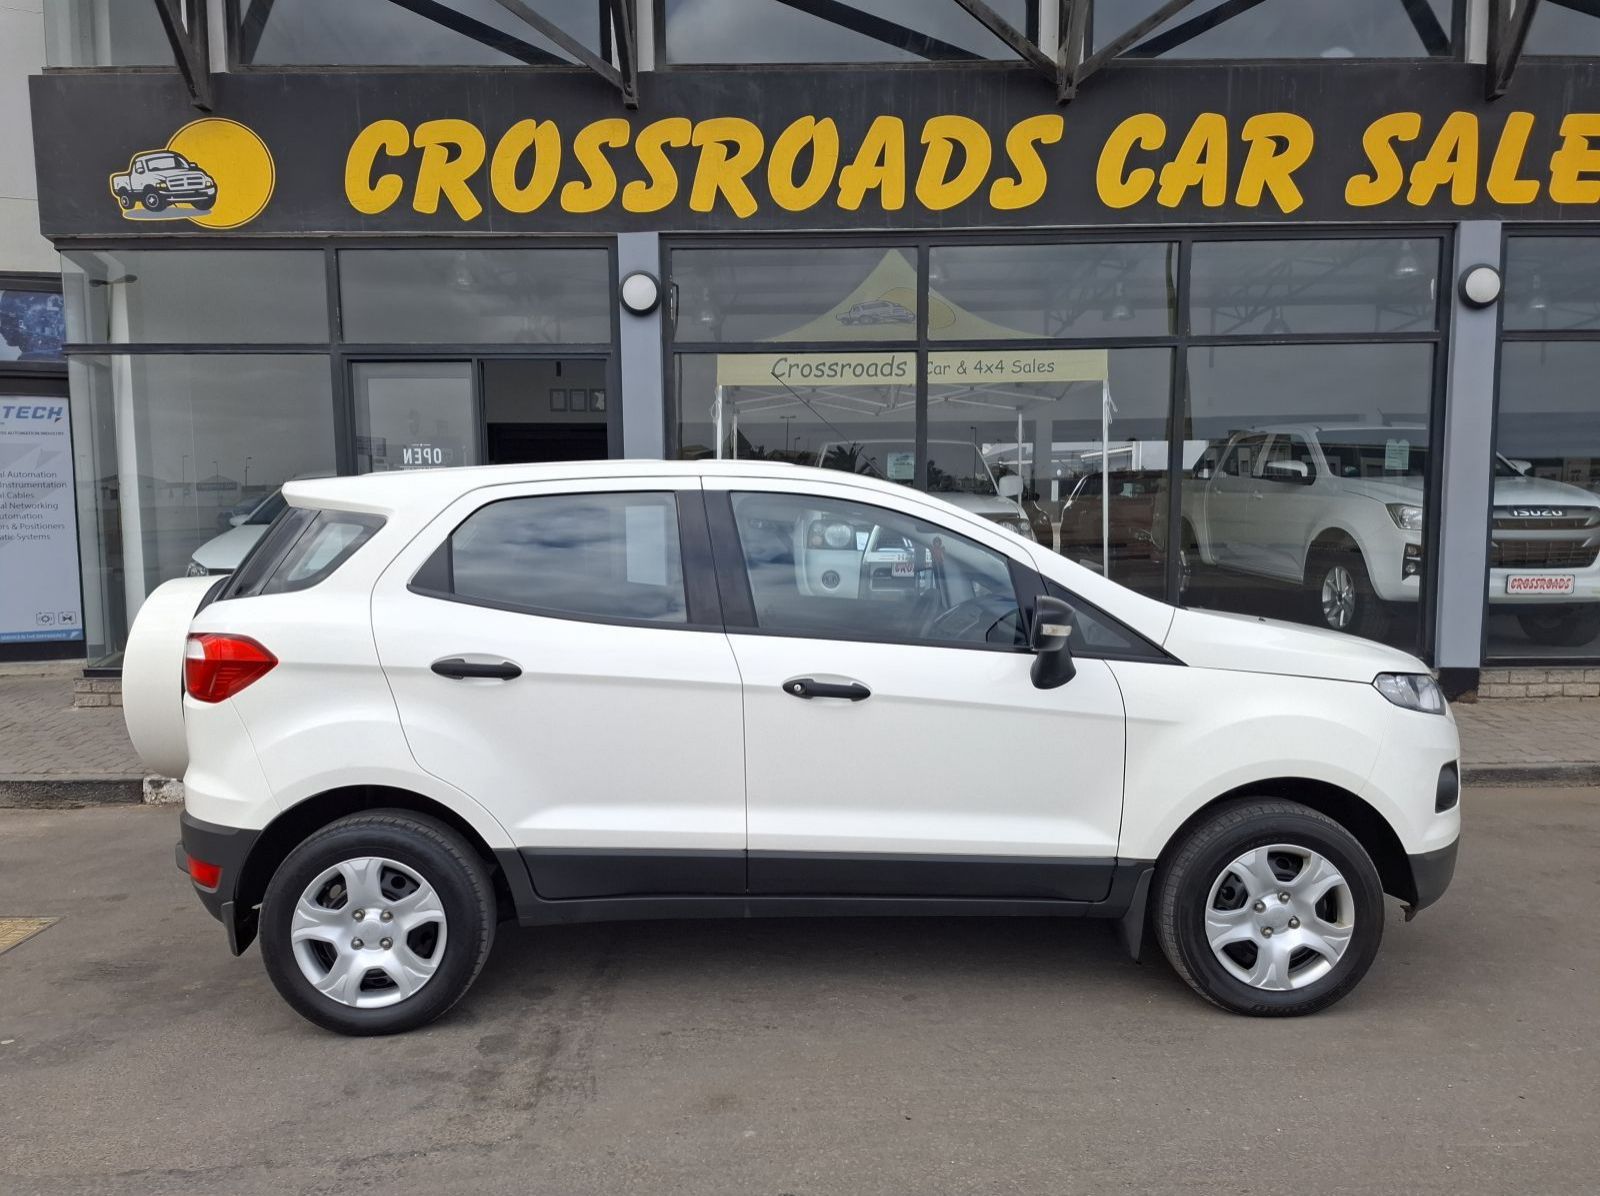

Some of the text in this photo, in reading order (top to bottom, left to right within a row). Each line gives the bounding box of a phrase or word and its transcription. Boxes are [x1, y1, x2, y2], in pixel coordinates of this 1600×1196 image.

[344, 110, 1600, 221] CROSSROADS CAR SALE
[771, 355, 1056, 379] Crossroads Car & 4x4 Sales
[2, 405, 63, 420] TECH
[7, 470, 57, 479] Automation
[6, 491, 34, 500] Cables
[9, 501, 59, 511] Networking
[19, 522, 65, 530] Positioners
[16, 533, 51, 541] Systems
[1510, 577, 1572, 591] CROSSROADS
